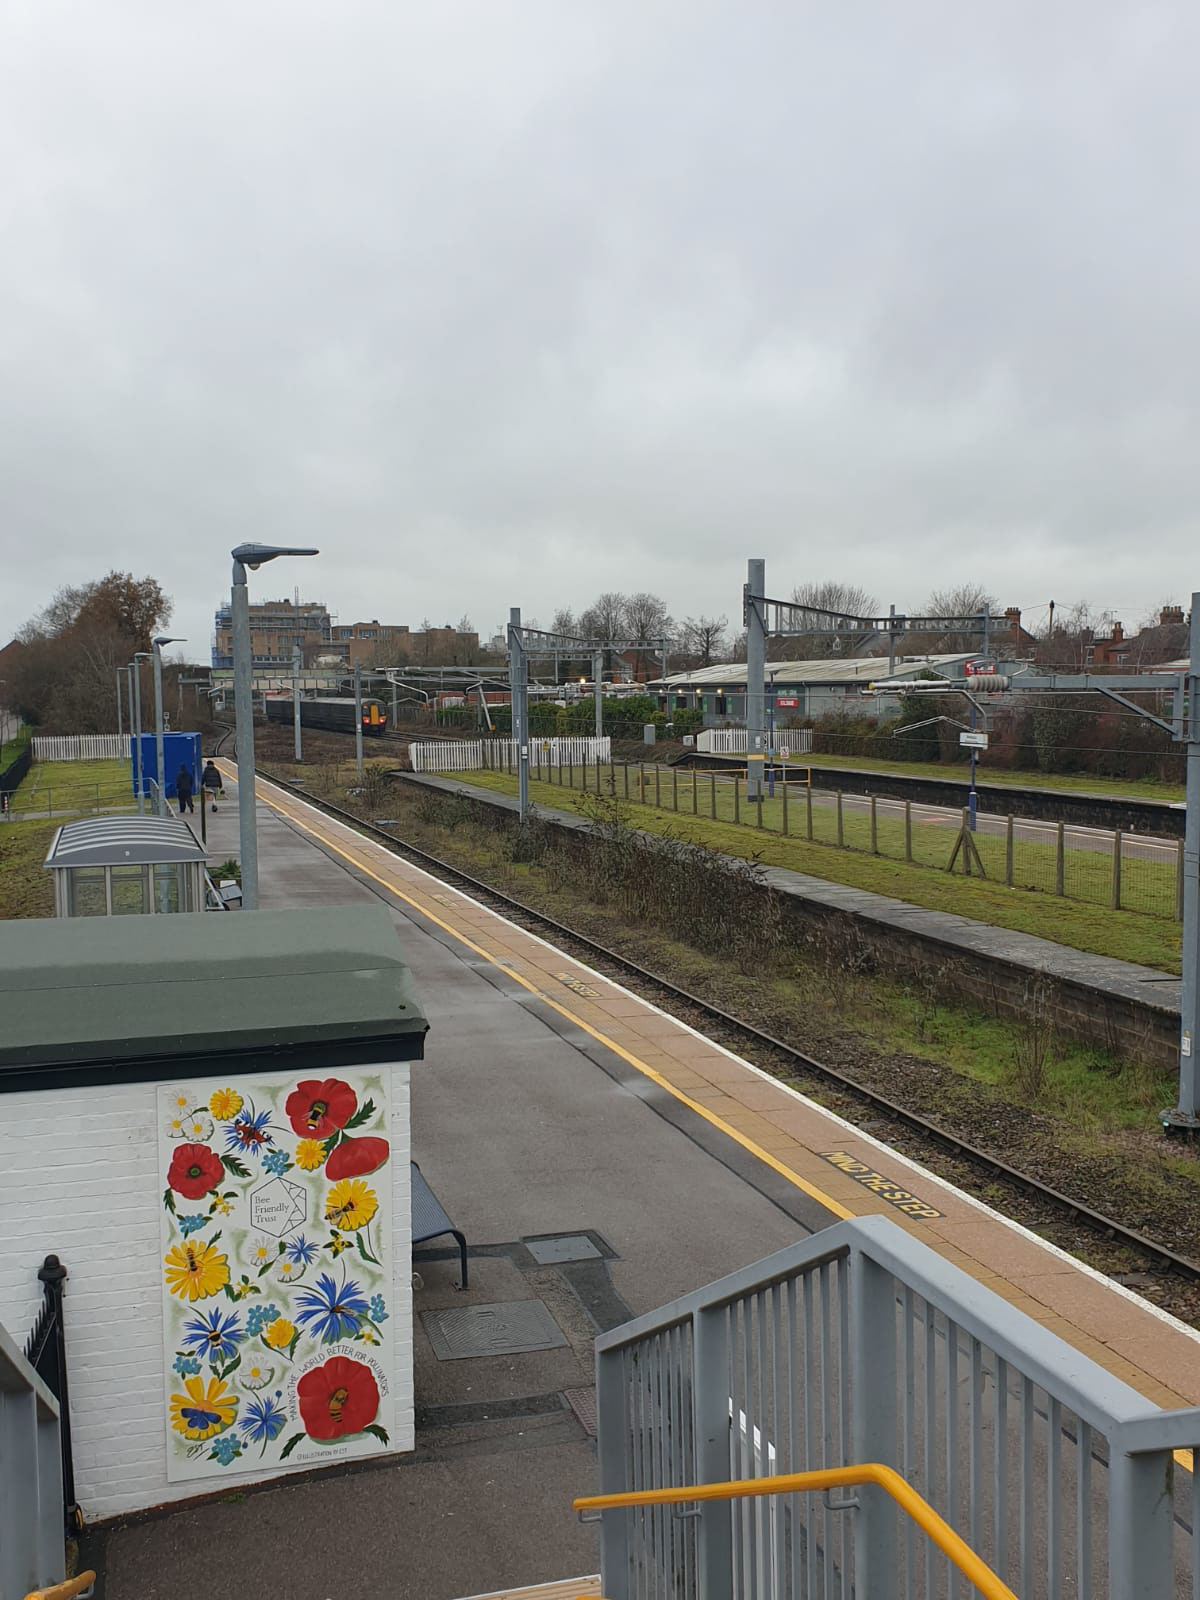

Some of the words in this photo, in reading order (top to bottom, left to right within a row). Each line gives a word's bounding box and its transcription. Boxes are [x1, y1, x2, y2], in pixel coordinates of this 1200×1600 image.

[820, 1151, 870, 1173] MIND
[854, 1172, 900, 1192] THE
[883, 1191, 941, 1218] STEP
[255, 1203, 289, 1214] Friendly
[255, 1214, 277, 1223] Trust
[327, 1345, 354, 1356] BETTER
[354, 1351, 367, 1361] FOR
[299, 1353, 325, 1373] WORLD
[287, 1375, 298, 1388] THE
[368, 1358, 389, 1397] POLLINATORS
[288, 1391, 297, 1421] MAKING
